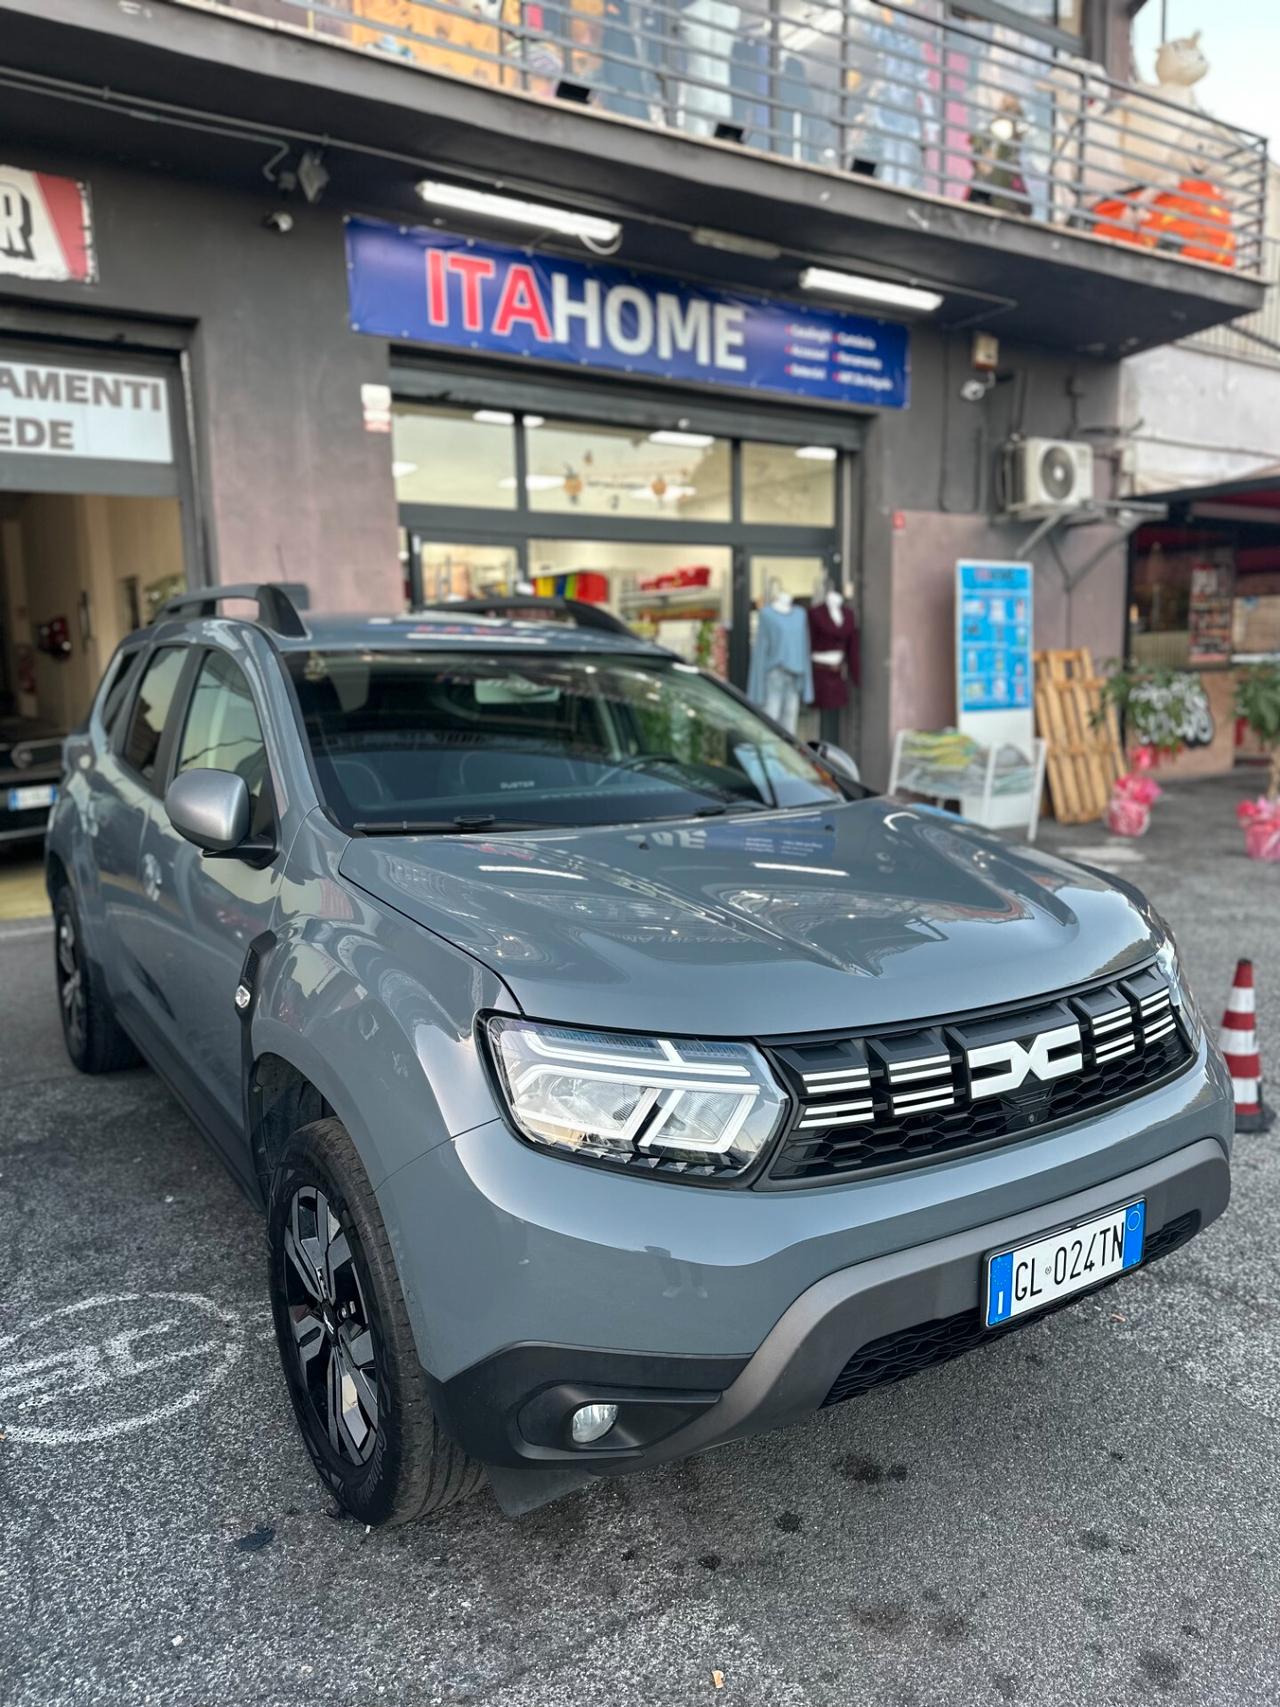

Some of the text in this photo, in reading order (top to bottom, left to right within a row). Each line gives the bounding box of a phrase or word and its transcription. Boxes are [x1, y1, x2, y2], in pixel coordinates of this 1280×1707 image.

[426, 247, 747, 371] ITAHOME
[1014, 1221, 1125, 1301] GL 024TN
